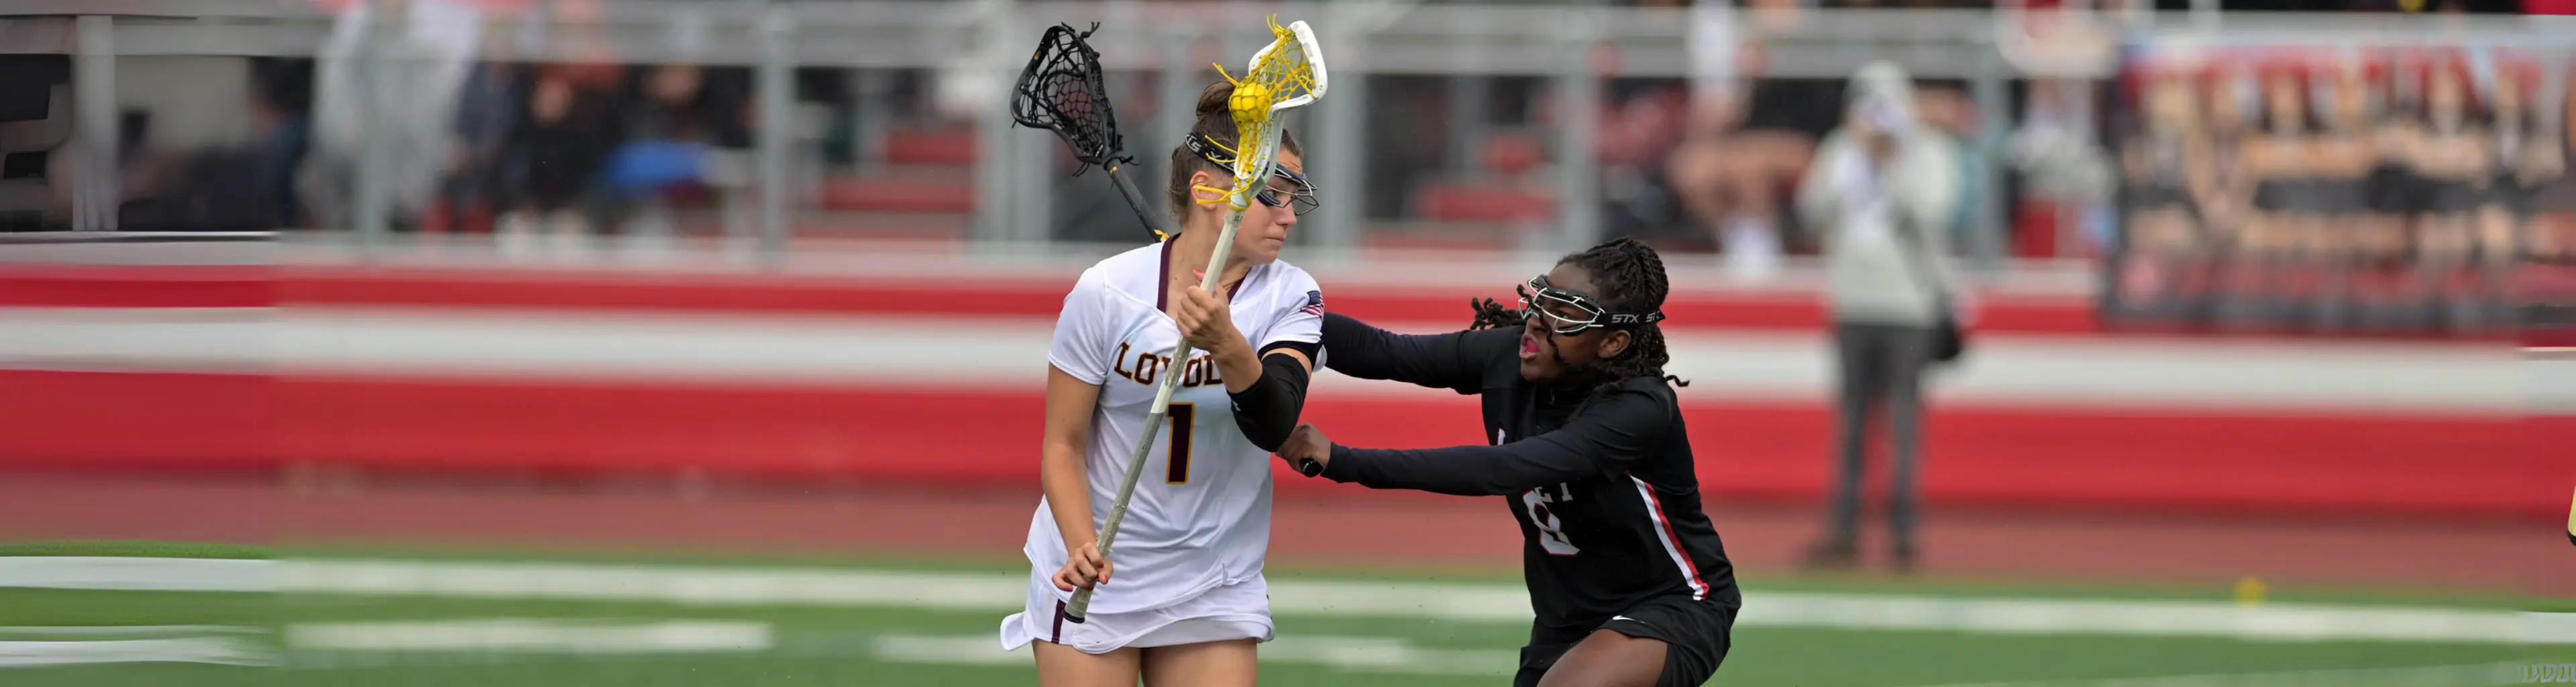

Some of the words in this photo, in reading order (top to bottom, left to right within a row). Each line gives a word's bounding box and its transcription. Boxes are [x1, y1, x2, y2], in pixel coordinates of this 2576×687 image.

[1611, 313, 1640, 323] STX
[1114, 342, 1224, 388] LOOL
[1166, 402, 1195, 485] 1
